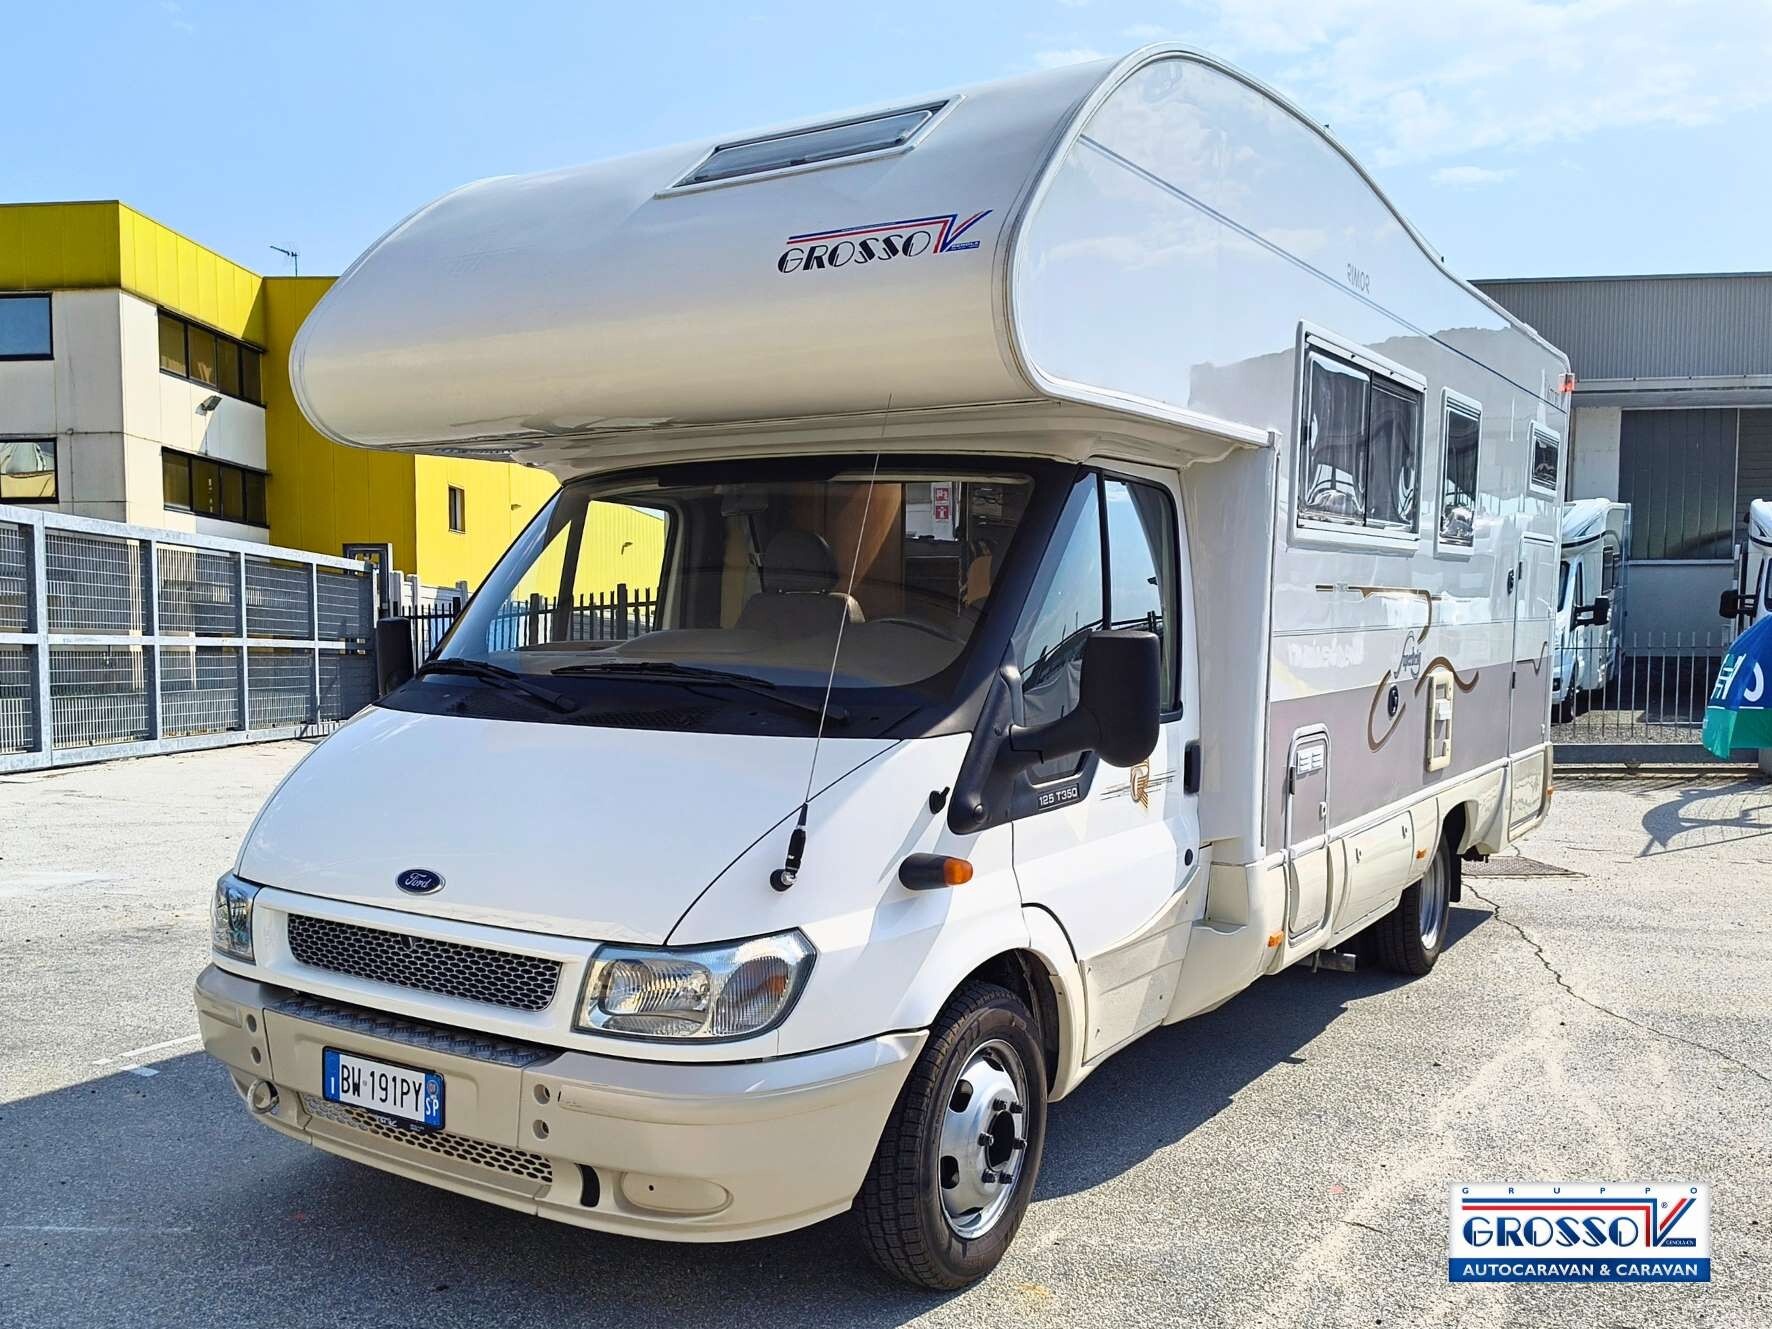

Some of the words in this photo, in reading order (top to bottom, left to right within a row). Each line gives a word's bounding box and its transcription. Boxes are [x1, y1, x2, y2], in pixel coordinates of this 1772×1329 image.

[778, 230, 932, 274] GROSSO
[1039, 794, 1055, 806] 125
[1055, 787, 1078, 800] T350
[404, 872, 432, 888] Ford
[370, 1070, 422, 1113] 191PY
[425, 1097, 440, 1117] SP
